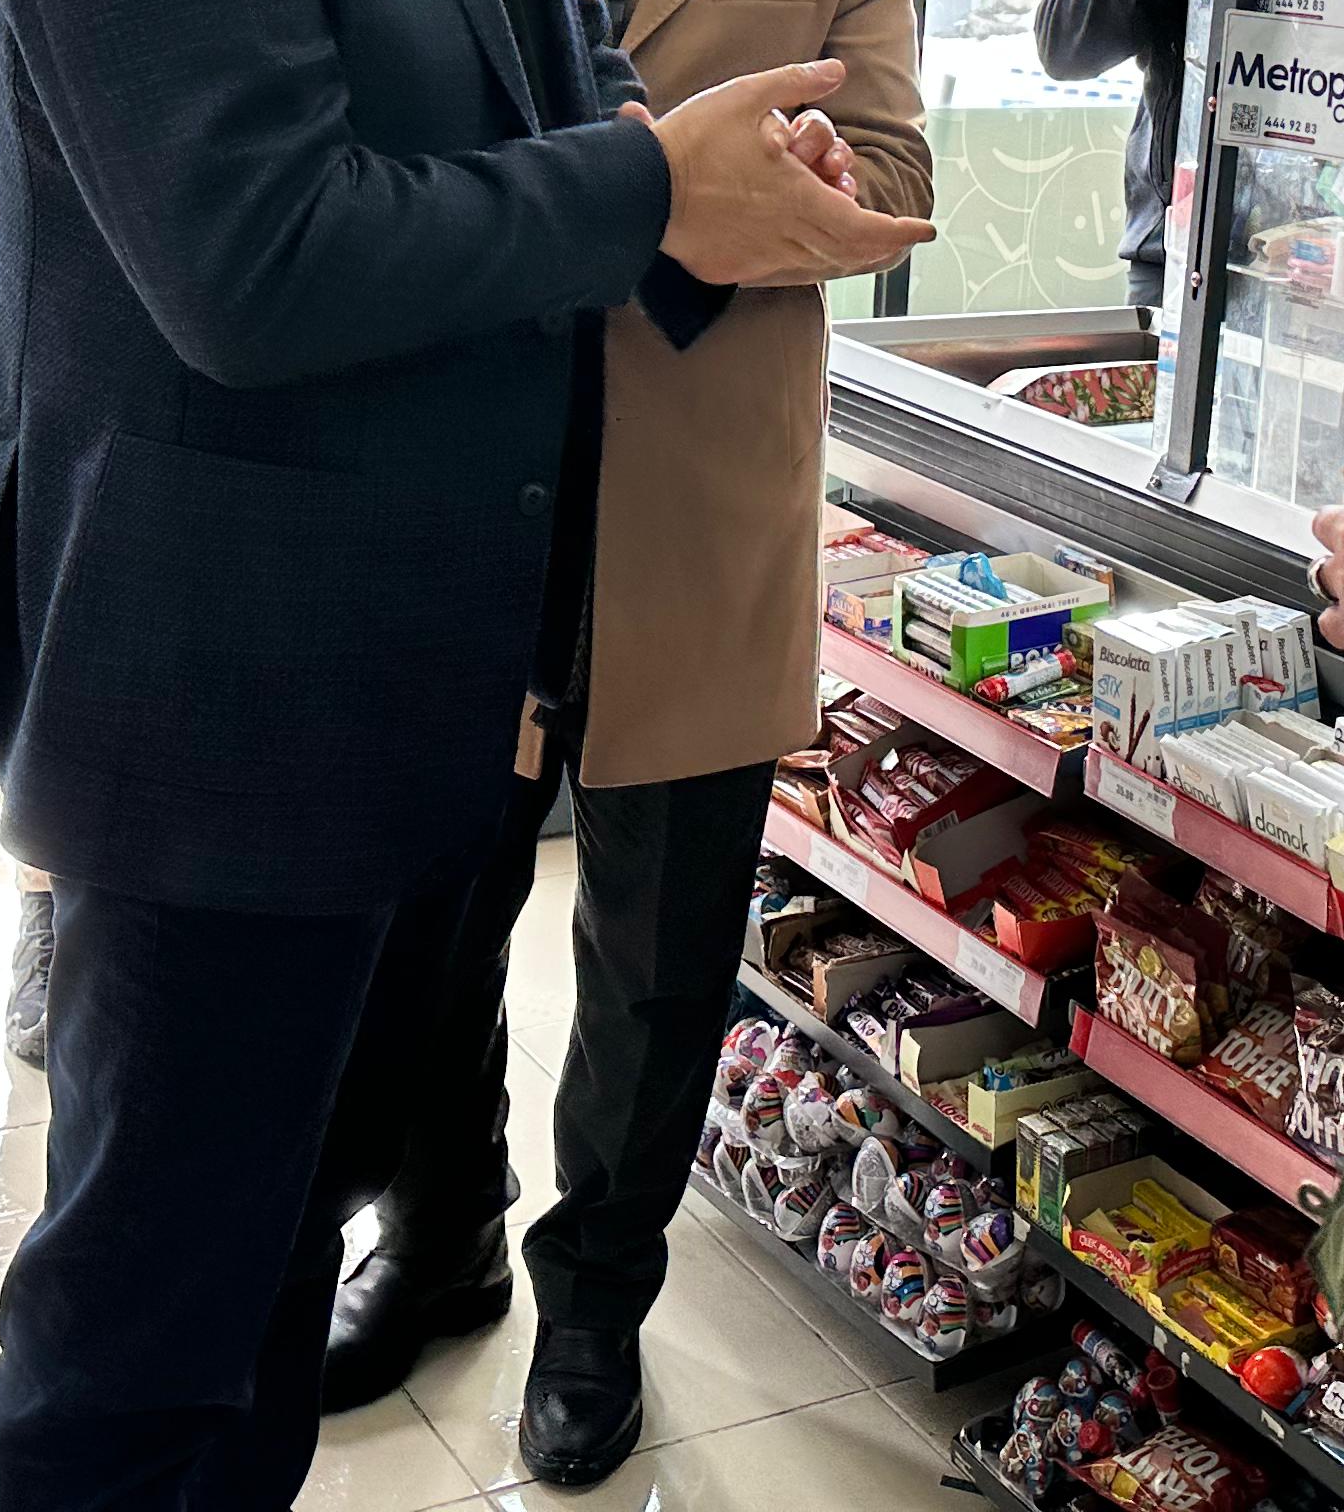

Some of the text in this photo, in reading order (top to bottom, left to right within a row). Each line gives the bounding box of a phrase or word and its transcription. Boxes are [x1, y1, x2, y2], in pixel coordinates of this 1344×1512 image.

[1312, 0, 1325, 11] 83
[1264, 116, 1318, 135] 444 92 83
[1099, 645, 1151, 673] Biscolata
[1241, 619, 1256, 665] Biscolata
[1277, 637, 1290, 680] Biscolata
[1296, 626, 1312, 670] Biscolata
[1159, 658, 1171, 702] Biscolata
[1182, 652, 1194, 697] Biscolata
[1203, 647, 1215, 692] Biscolata
[1225, 643, 1237, 687] Biscolata
[1209, 1028, 1298, 1099] TOFFEE
